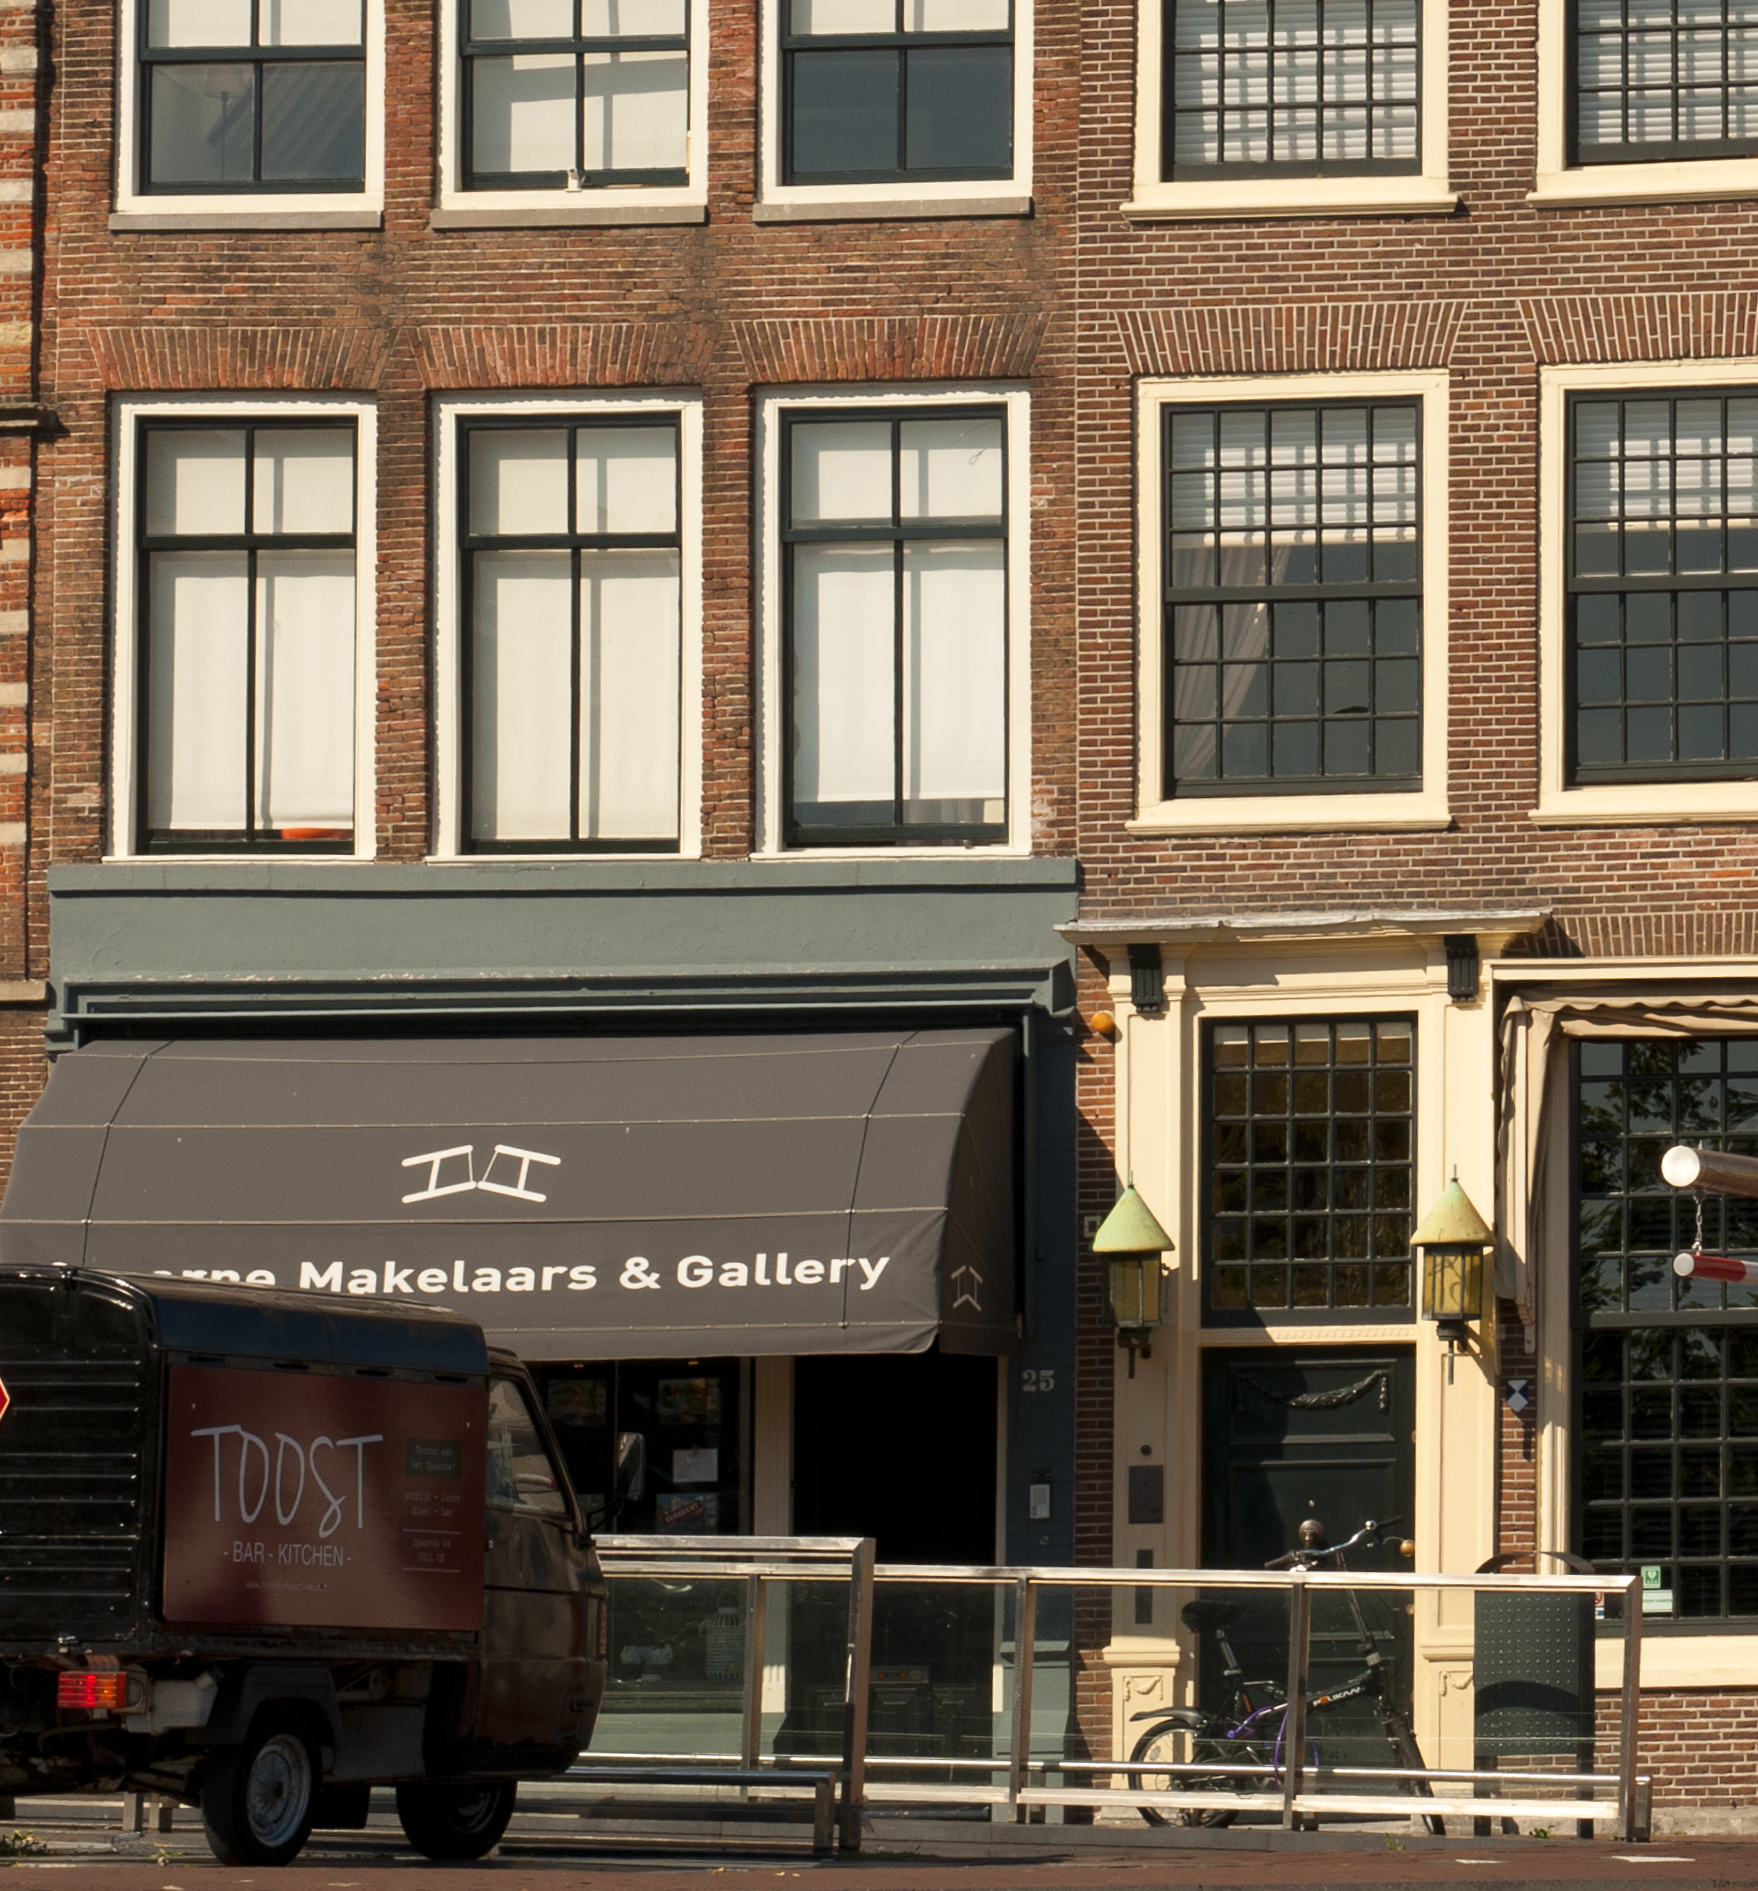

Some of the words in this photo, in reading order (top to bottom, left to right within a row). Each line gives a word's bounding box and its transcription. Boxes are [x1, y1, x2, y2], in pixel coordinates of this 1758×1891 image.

[300, 1259, 597, 1295] Makelaars
[619, 1256, 661, 1290] &
[677, 1252, 890, 1291] Gallery
[1022, 1369, 1055, 1392] 25
[190, 1423, 384, 1539] TOOST
[233, 1540, 265, 1563] BAR
[278, 1543, 344, 1567] KITCHEN
